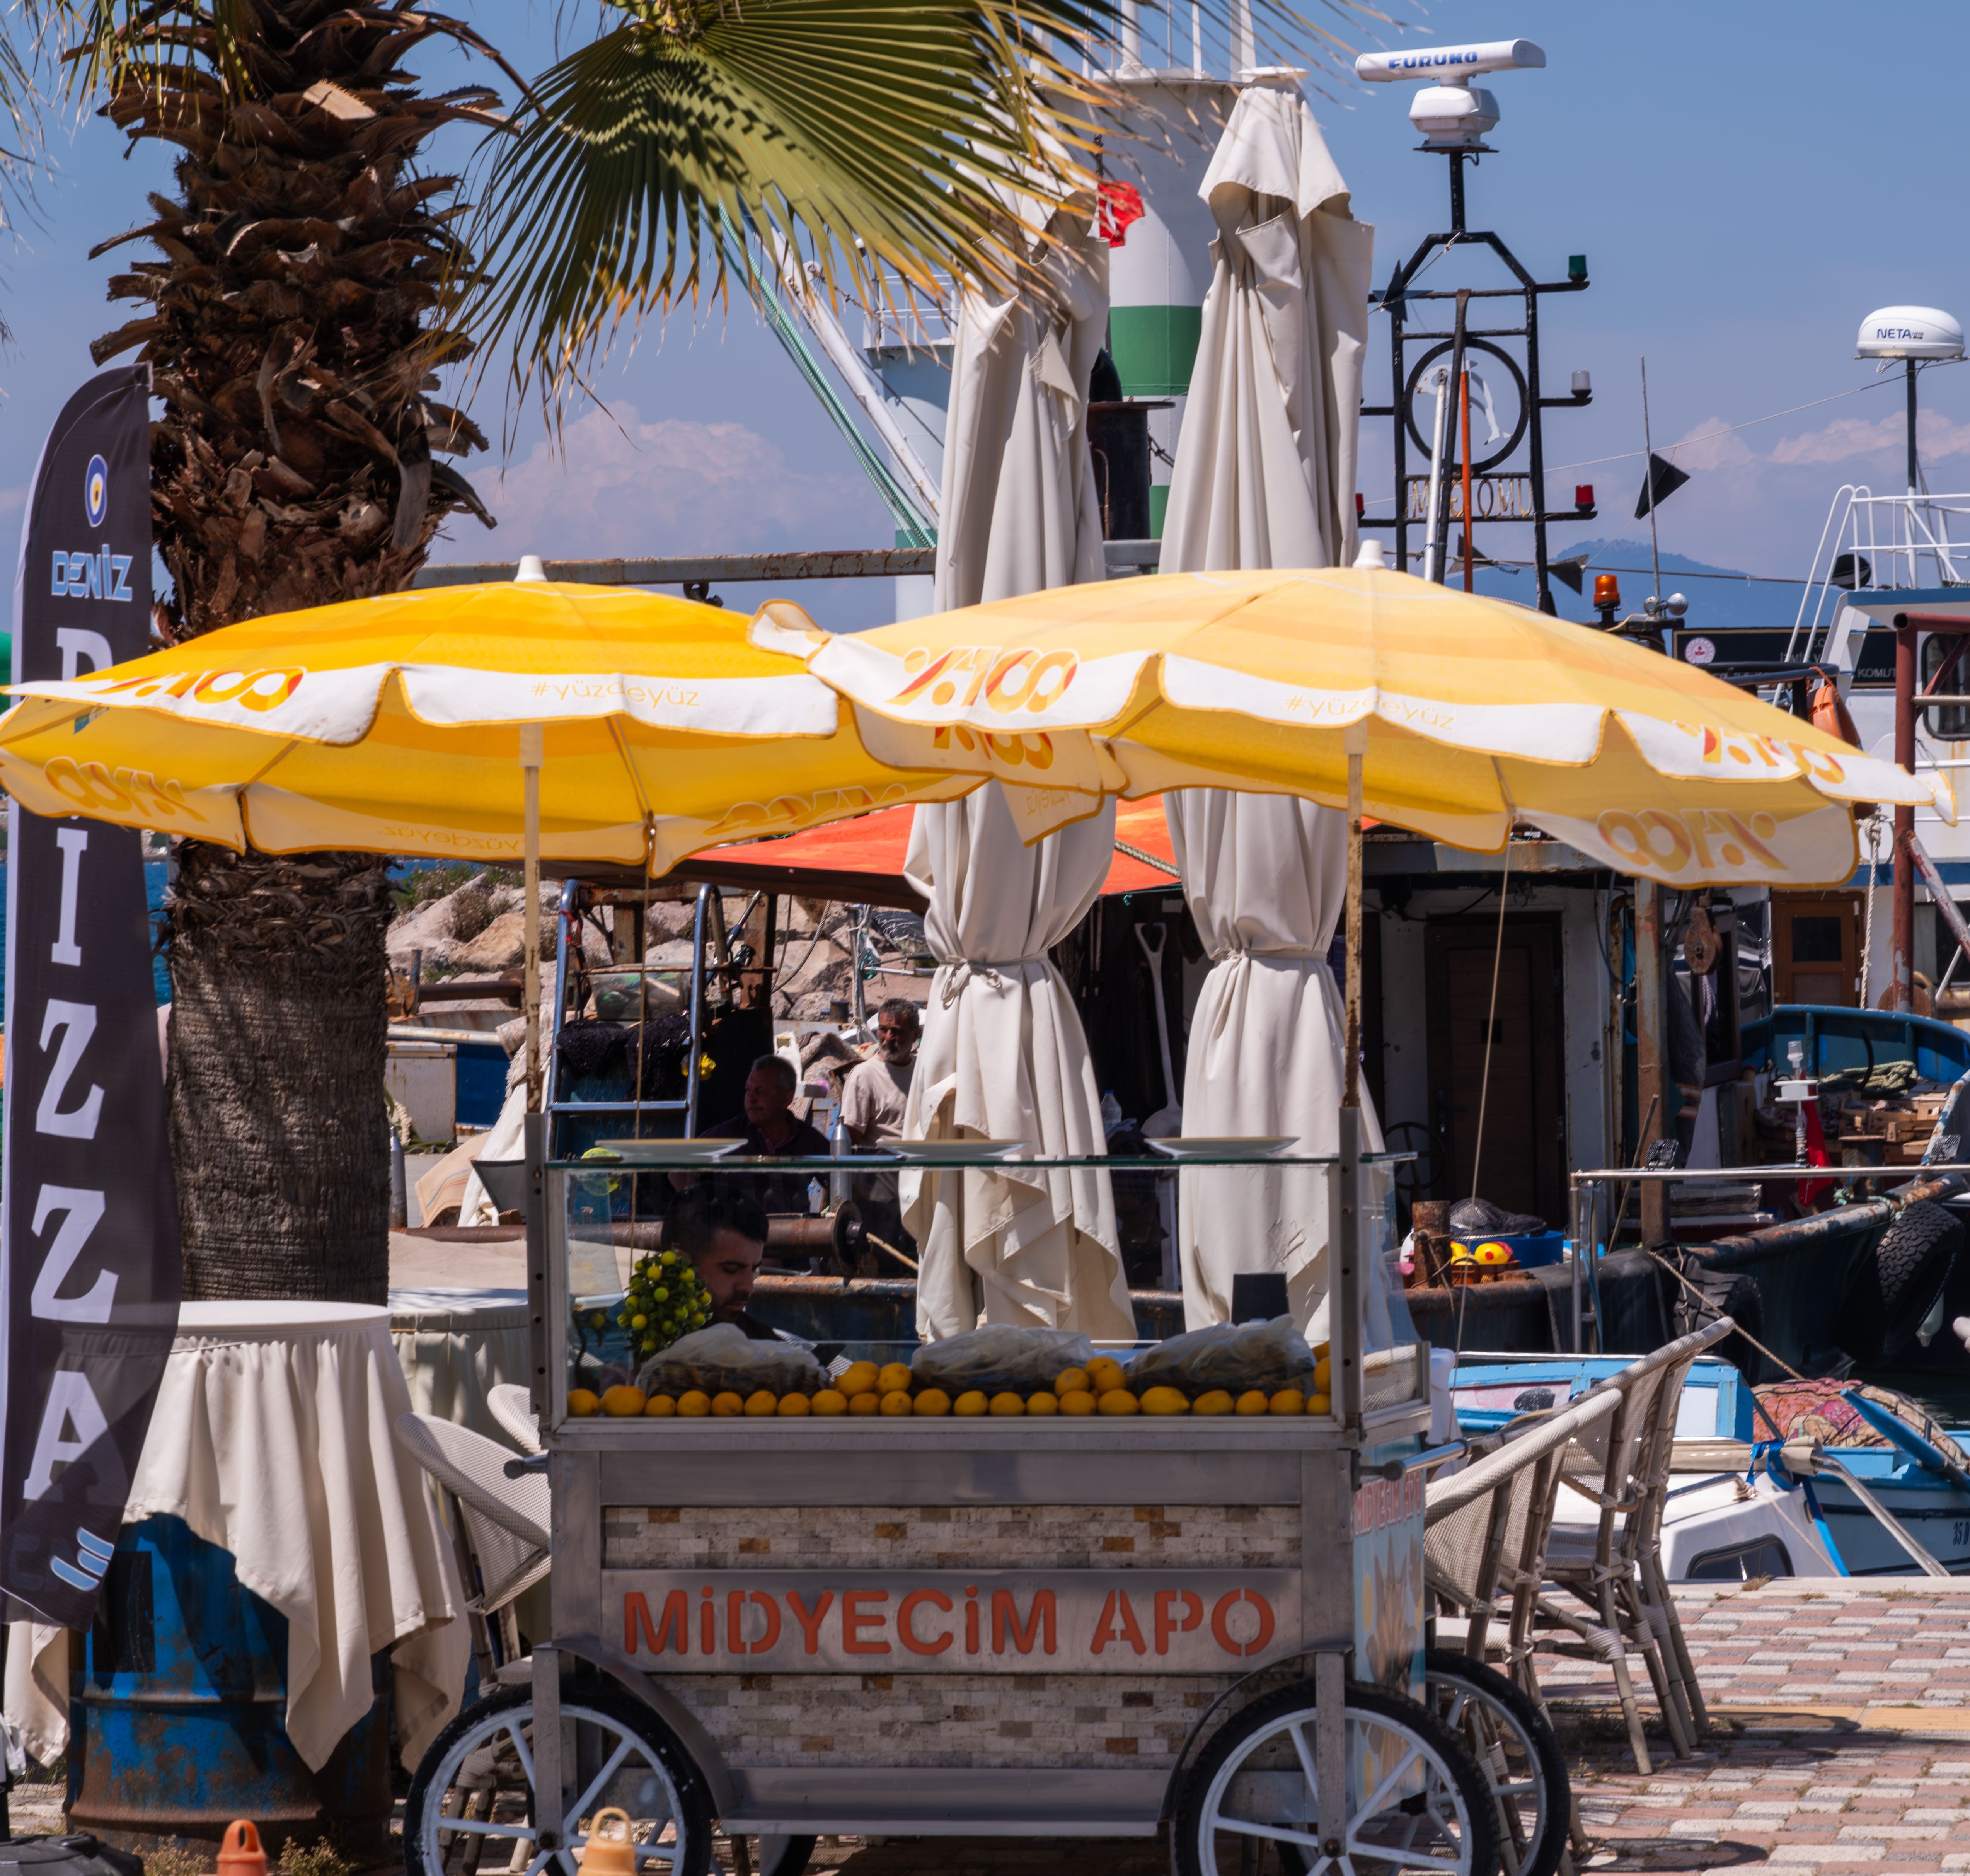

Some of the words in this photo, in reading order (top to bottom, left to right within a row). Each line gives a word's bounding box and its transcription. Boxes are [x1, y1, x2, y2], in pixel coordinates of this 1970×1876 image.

[1389, 51, 1478, 69] FURUNO
[1876, 328, 1912, 339] NETA
[1284, 692, 1455, 731] #yüzdeyüz
[1091, 1588, 1275, 1656] APO
